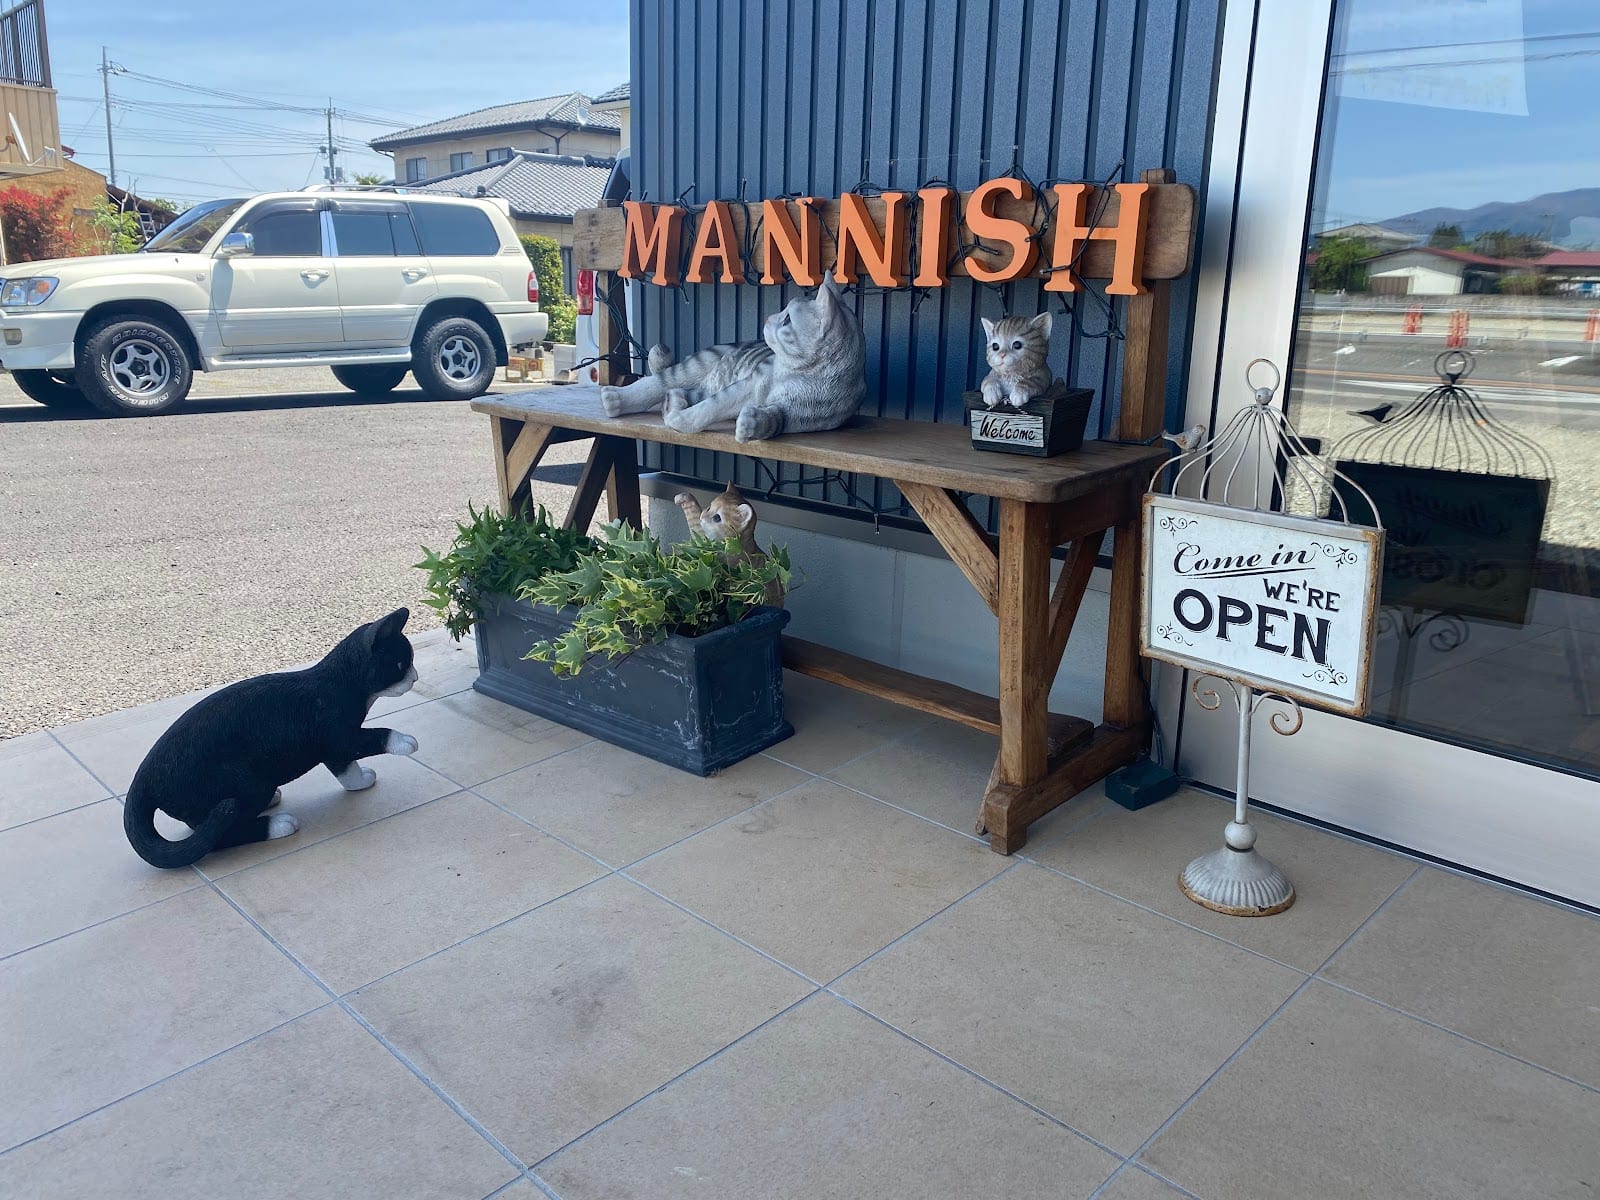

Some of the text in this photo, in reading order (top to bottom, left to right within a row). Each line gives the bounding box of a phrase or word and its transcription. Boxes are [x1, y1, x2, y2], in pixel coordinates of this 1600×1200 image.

[617, 177, 1149, 296] MANNISH
[980, 415, 1036, 440] Welcome
[1173, 542, 1317, 575] Come in
[1263, 578, 1341, 612] WE'RE
[1173, 588, 1333, 668] OPEN
